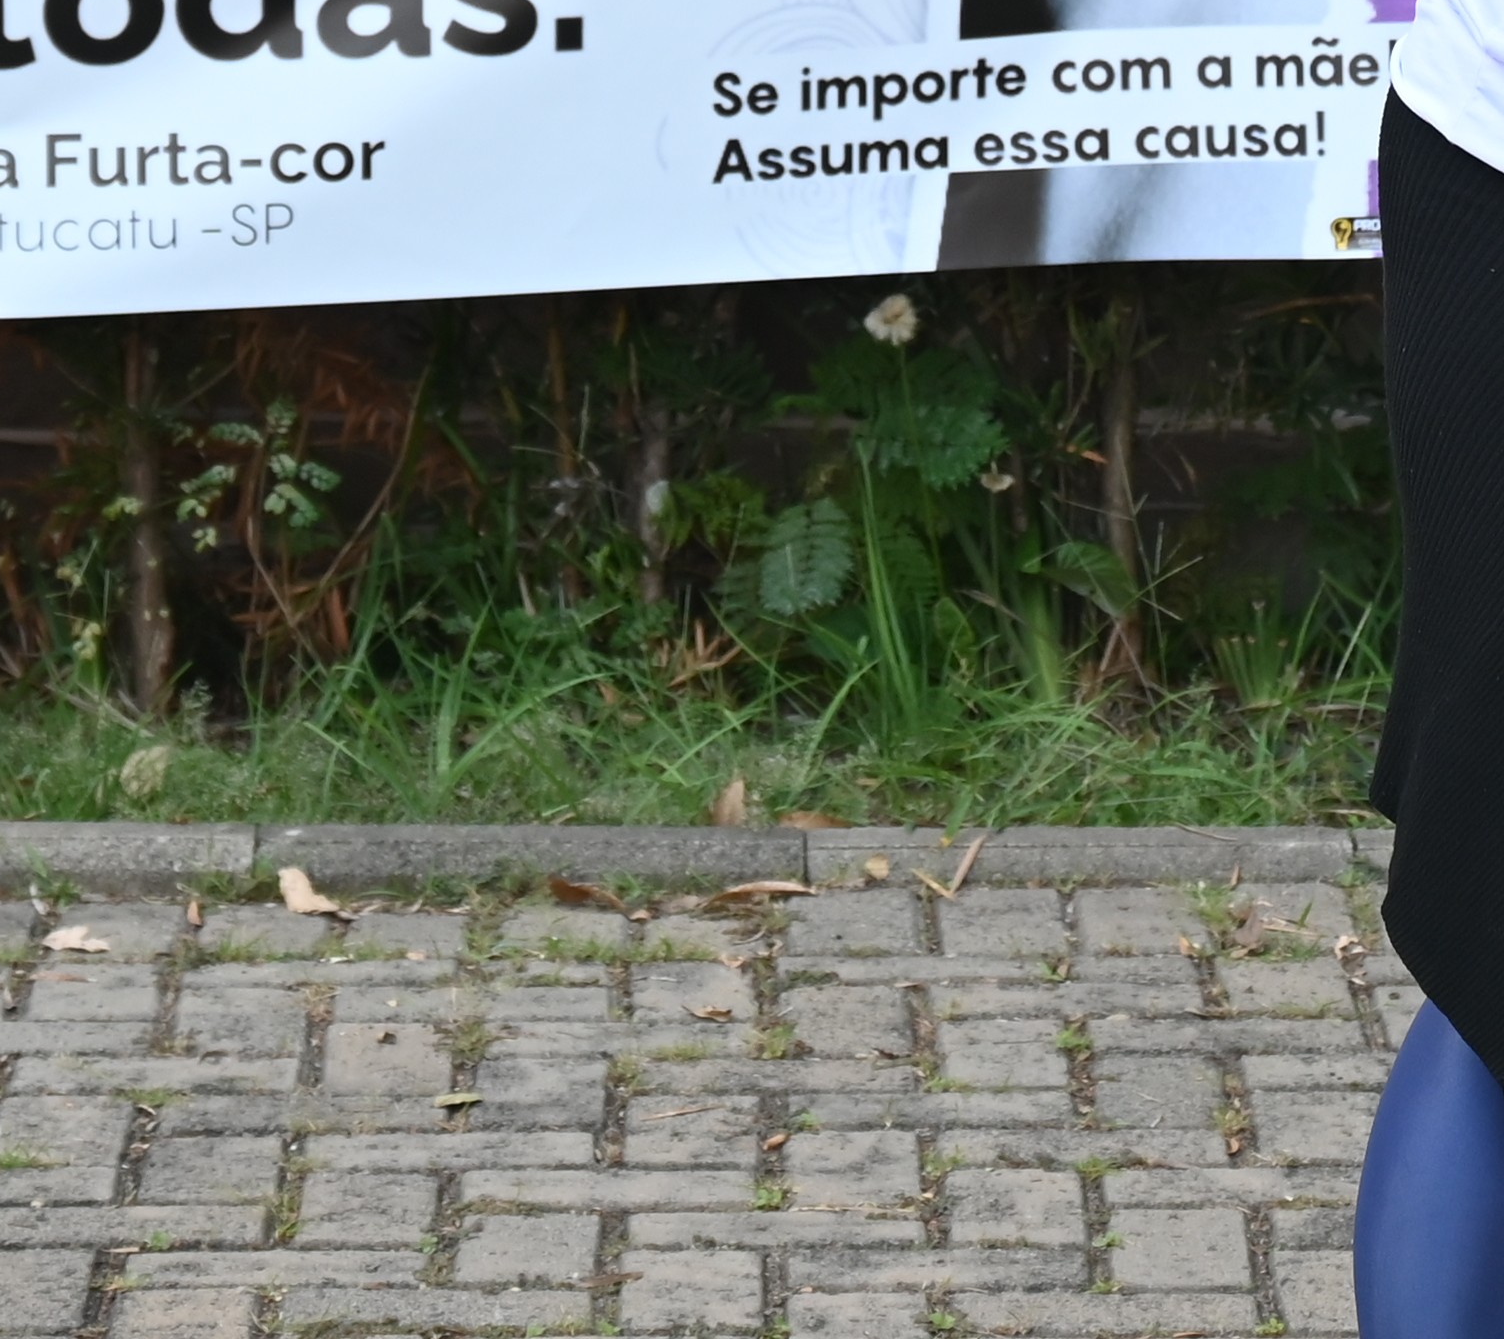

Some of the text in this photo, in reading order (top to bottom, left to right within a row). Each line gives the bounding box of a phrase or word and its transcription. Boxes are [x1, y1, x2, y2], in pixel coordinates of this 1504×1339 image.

[711, 72, 780, 118] Se
[800, 58, 1027, 121] importe
[1052, 47, 1173, 94] com
[1197, 50, 1233, 89] a
[44, 133, 385, 189] Furta-cor
[711, 111, 1328, 184] Assuma essa causa!
